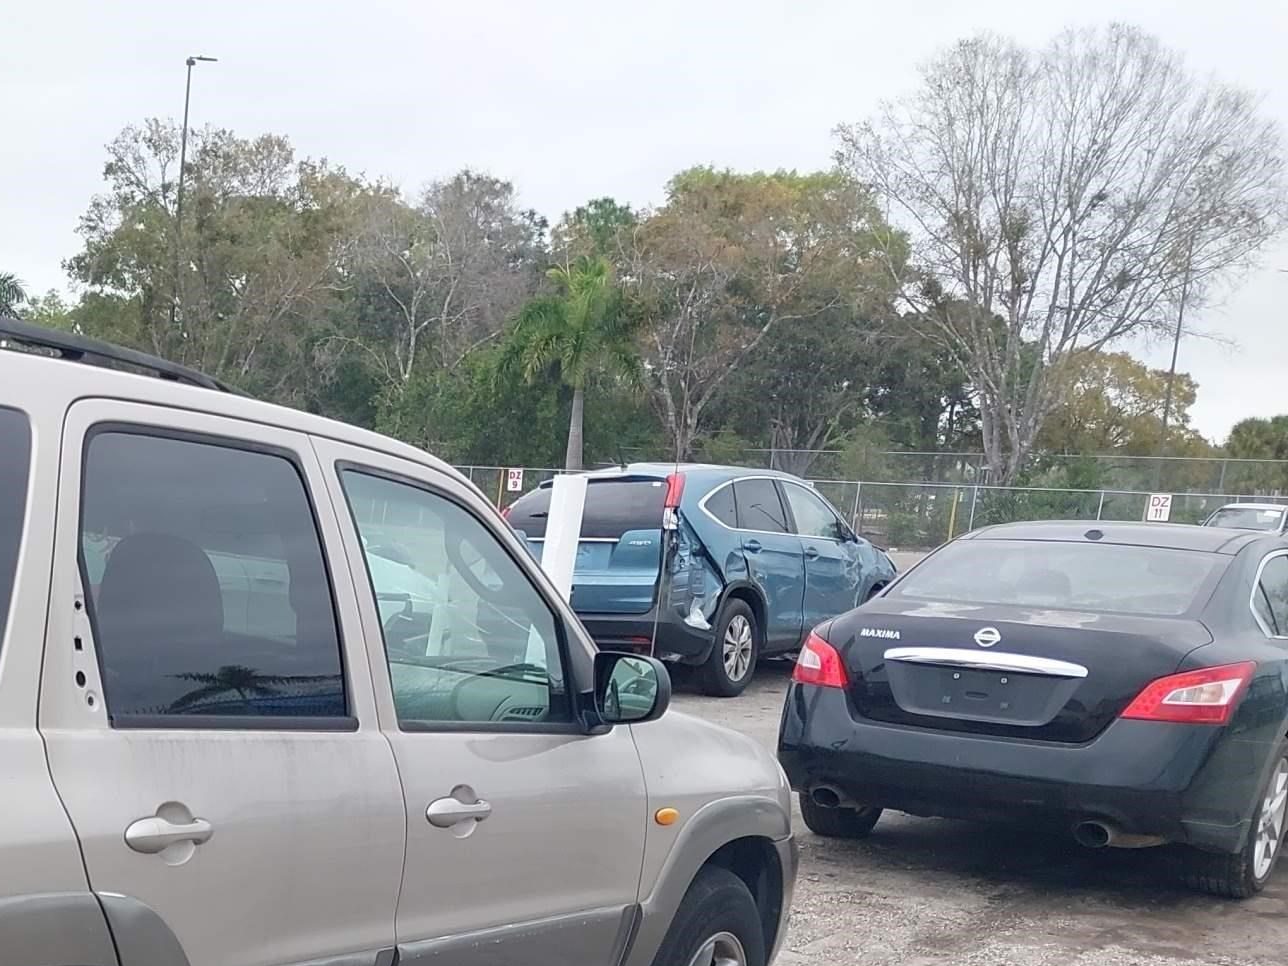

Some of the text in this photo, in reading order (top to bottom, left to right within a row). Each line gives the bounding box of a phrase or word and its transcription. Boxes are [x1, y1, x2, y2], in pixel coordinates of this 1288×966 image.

[509, 471, 522, 480] DZ
[512, 480, 518, 488] 9
[1152, 496, 1170, 507] DZ
[1154, 508, 1162, 519] 11
[860, 627, 901, 640] MAXIMA
